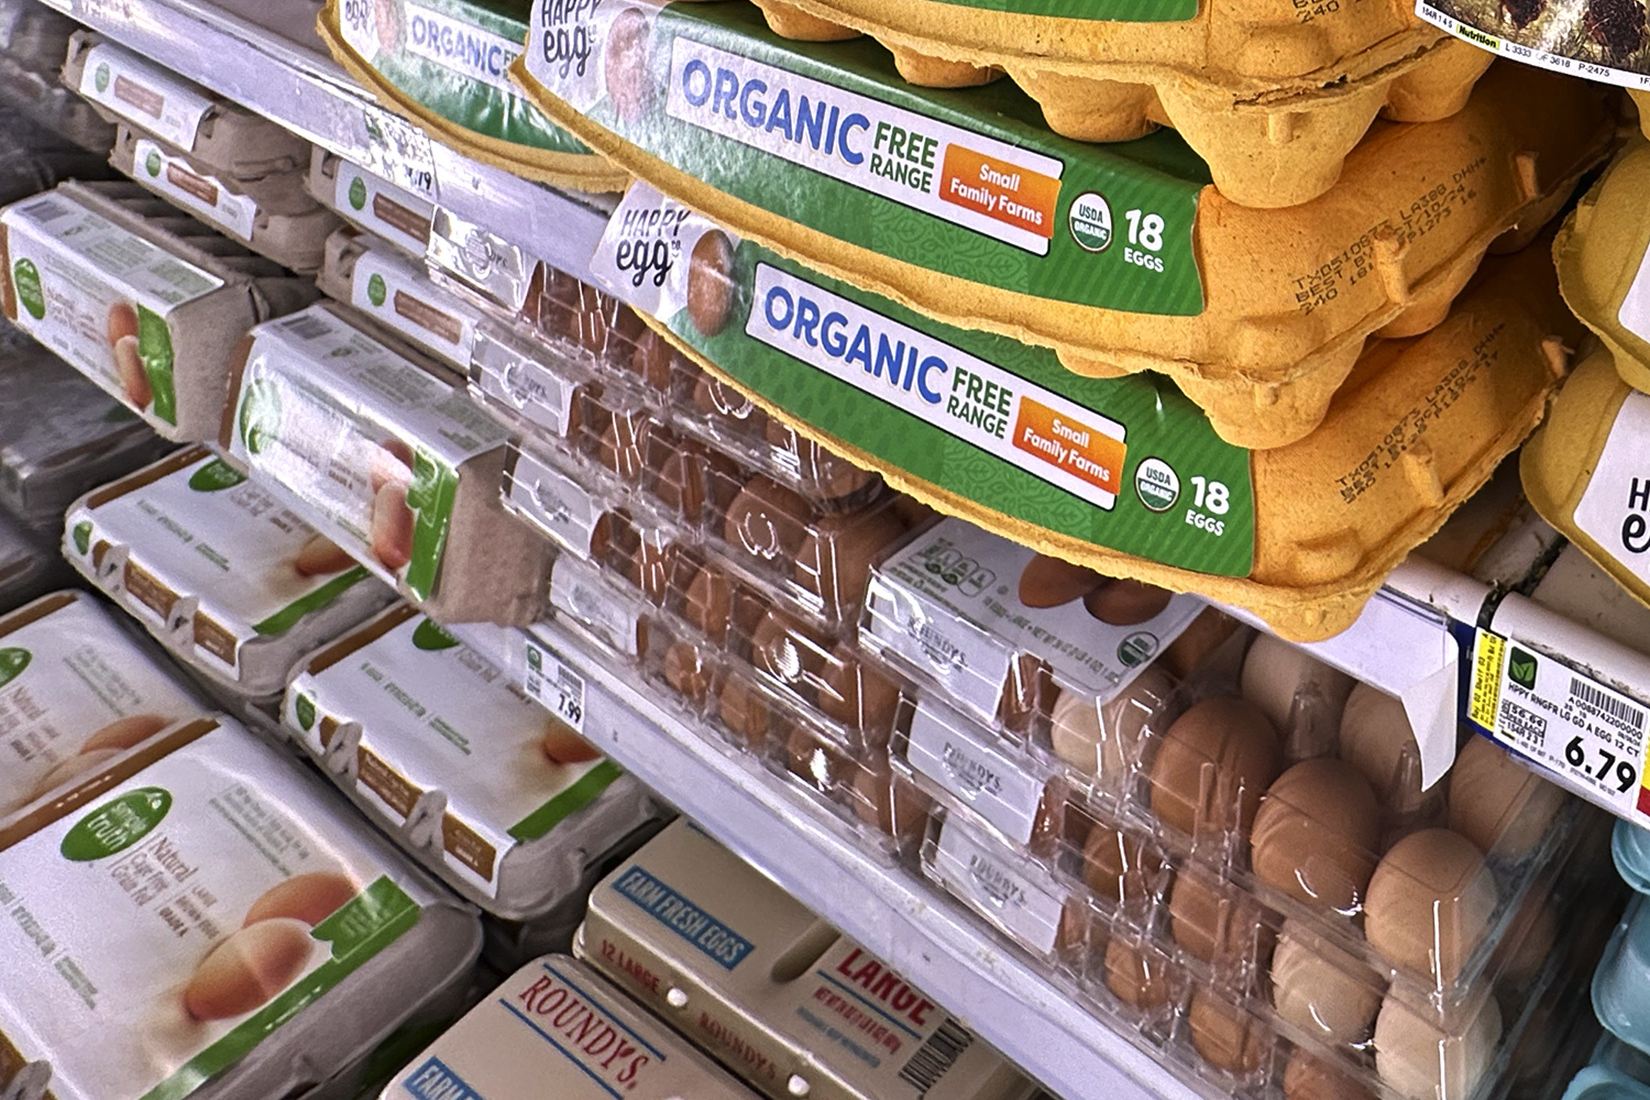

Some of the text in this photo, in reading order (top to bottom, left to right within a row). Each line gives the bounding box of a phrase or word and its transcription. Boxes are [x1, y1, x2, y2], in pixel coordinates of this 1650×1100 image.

[411, 15, 501, 76] ORGANIC
[682, 59, 1021, 193] ORGANIC FREE Small
[869, 156, 1044, 227] RANGE Family Farms
[620, 208, 691, 238] HAPPY
[1078, 203, 1104, 225] USDA
[1124, 208, 1165, 252] 18
[614, 236, 673, 288] egg
[1123, 246, 1165, 274] EGGS
[764, 285, 1091, 449] ORGANIC FREE Small
[946, 397, 1111, 483] RANGE Family Farms
[1144, 465, 1172, 487] USDA
[1190, 475, 1230, 515] 18
[1184, 509, 1226, 537] EGGS
[559, 692, 582, 724] 7.99
[1559, 709, 1571, 723] LG
[1572, 715, 1585, 729] GD
[1586, 723, 1593, 734] A
[1594, 727, 1612, 743] EGG
[1614, 739, 1625, 750] 12
[86, 812, 129, 851] truth
[152, 835, 199, 883] Natural
[620, 872, 747, 962] FARM FRESH EGGS
[601, 939, 662, 994] 12 LARGE
